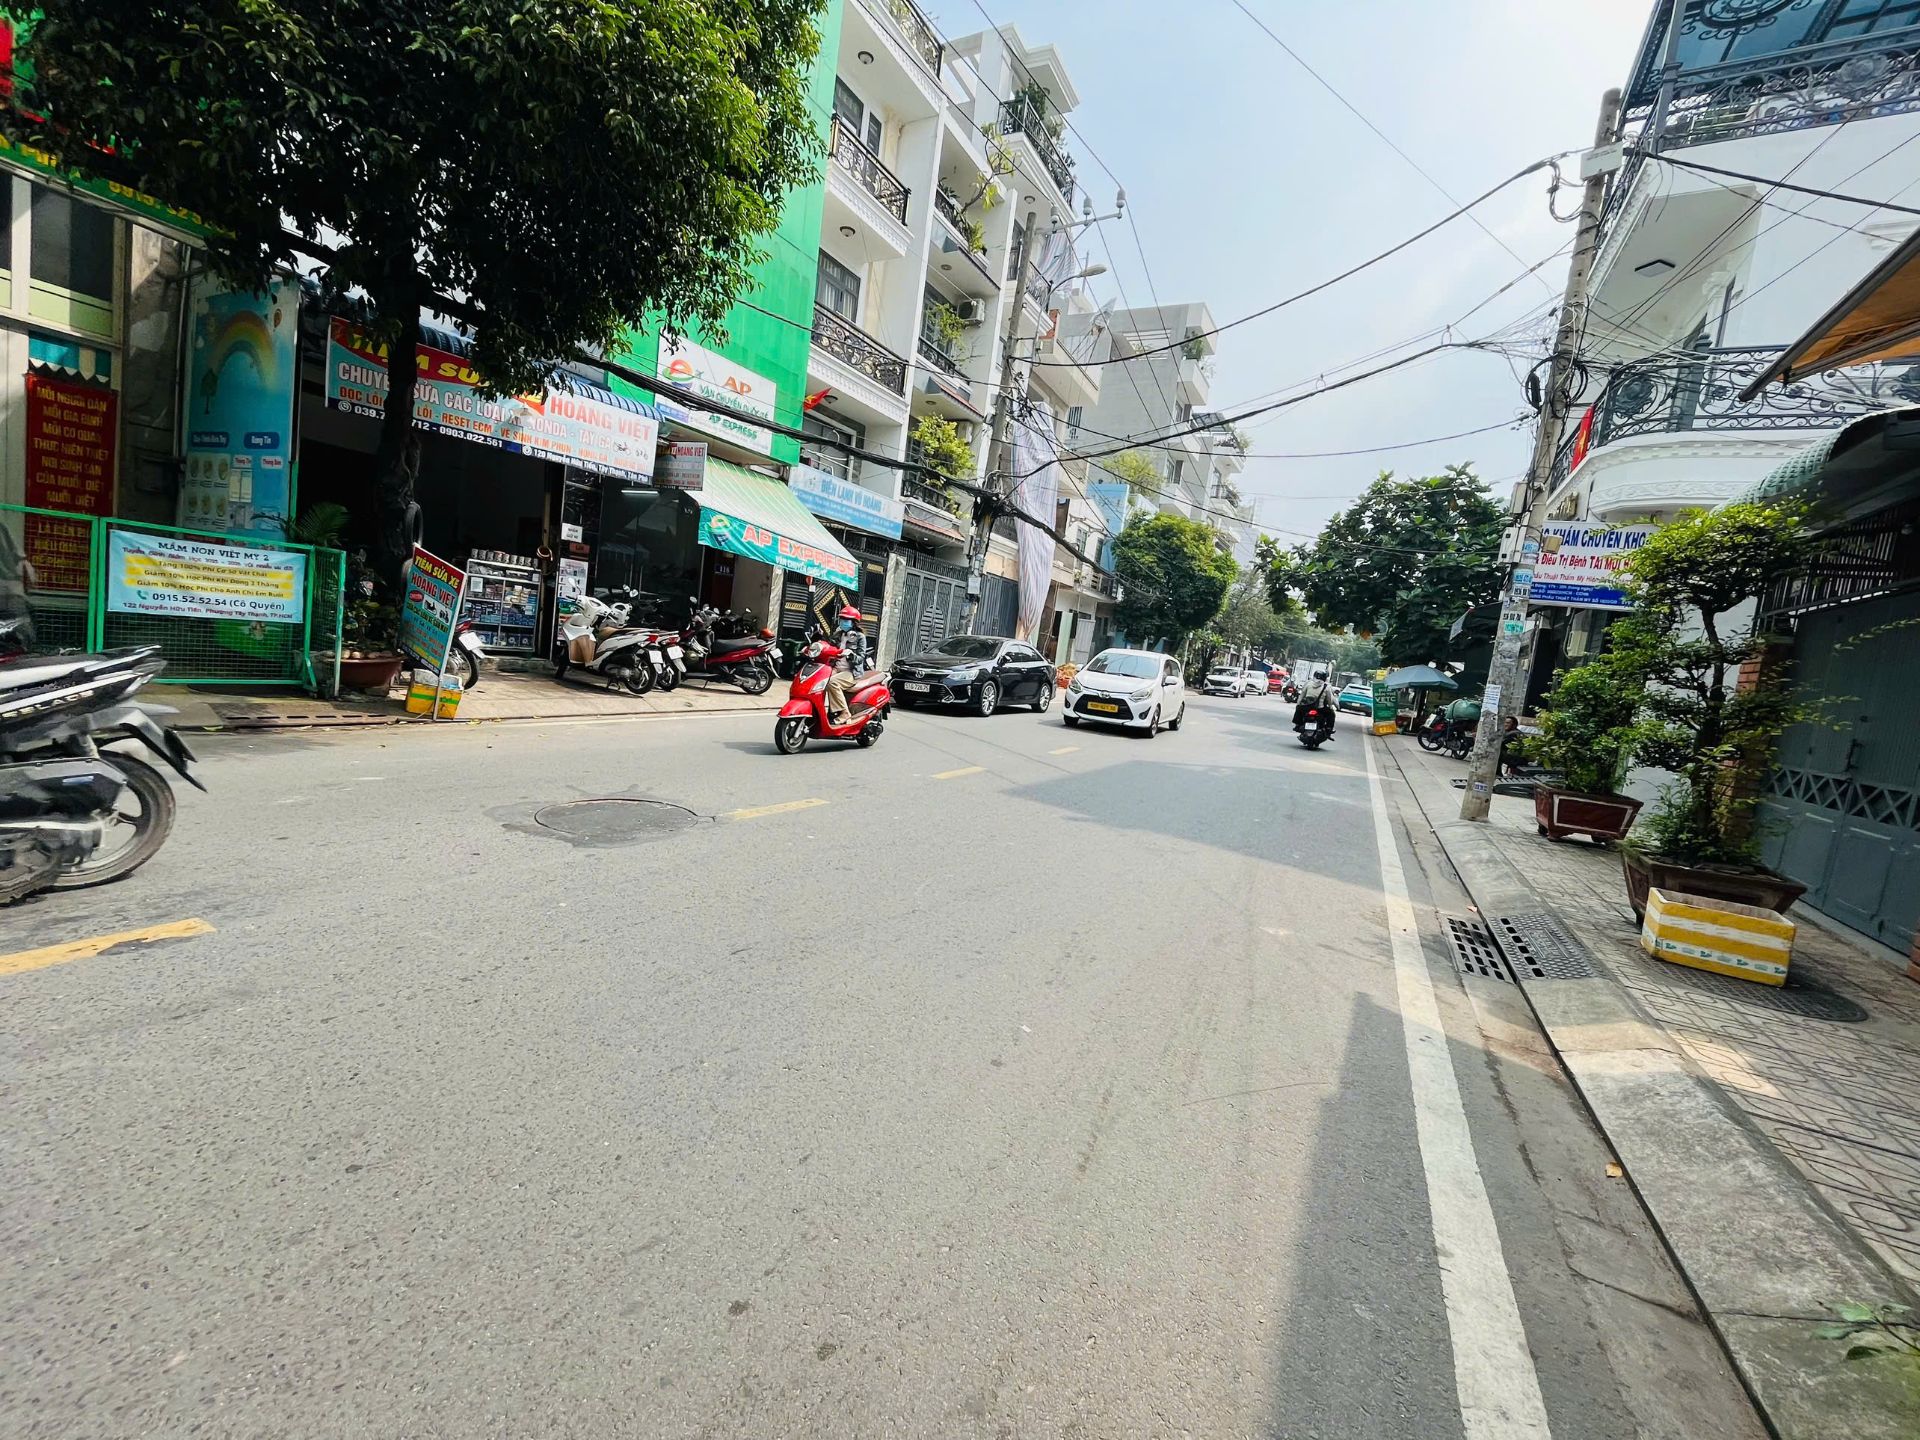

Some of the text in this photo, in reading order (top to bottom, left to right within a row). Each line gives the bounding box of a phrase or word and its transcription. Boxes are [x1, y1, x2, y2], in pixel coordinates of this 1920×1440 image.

[723, 376, 752, 396] AP
[445, 390, 473, 413] CÁC
[441, 413, 471, 428] RESET
[472, 420, 493, 434] ECM
[550, 394, 614, 432] HOÀNG
[619, 416, 652, 442] VIỆT
[722, 417, 758, 439] EXPRESS
[533, 448, 546, 458] 120
[191, 546, 215, 556] NON
[219, 549, 241, 559] VIỆT
[742, 524, 856, 578] AP EXPRESS
[179, 562, 200, 571] 100%
[1590, 555, 1603, 570] TAI
[432, 565, 448, 582] SỬA
[449, 575, 460, 590] XE
[209, 586, 226, 594] Cho
[413, 572, 438, 596] HOÀNG
[439, 588, 456, 610] VIỆT
[152, 592, 228, 606] 0915.52.52.54
[229, 599, 246, 609] (Cô
[1375, 696, 1397, 704] VETC
